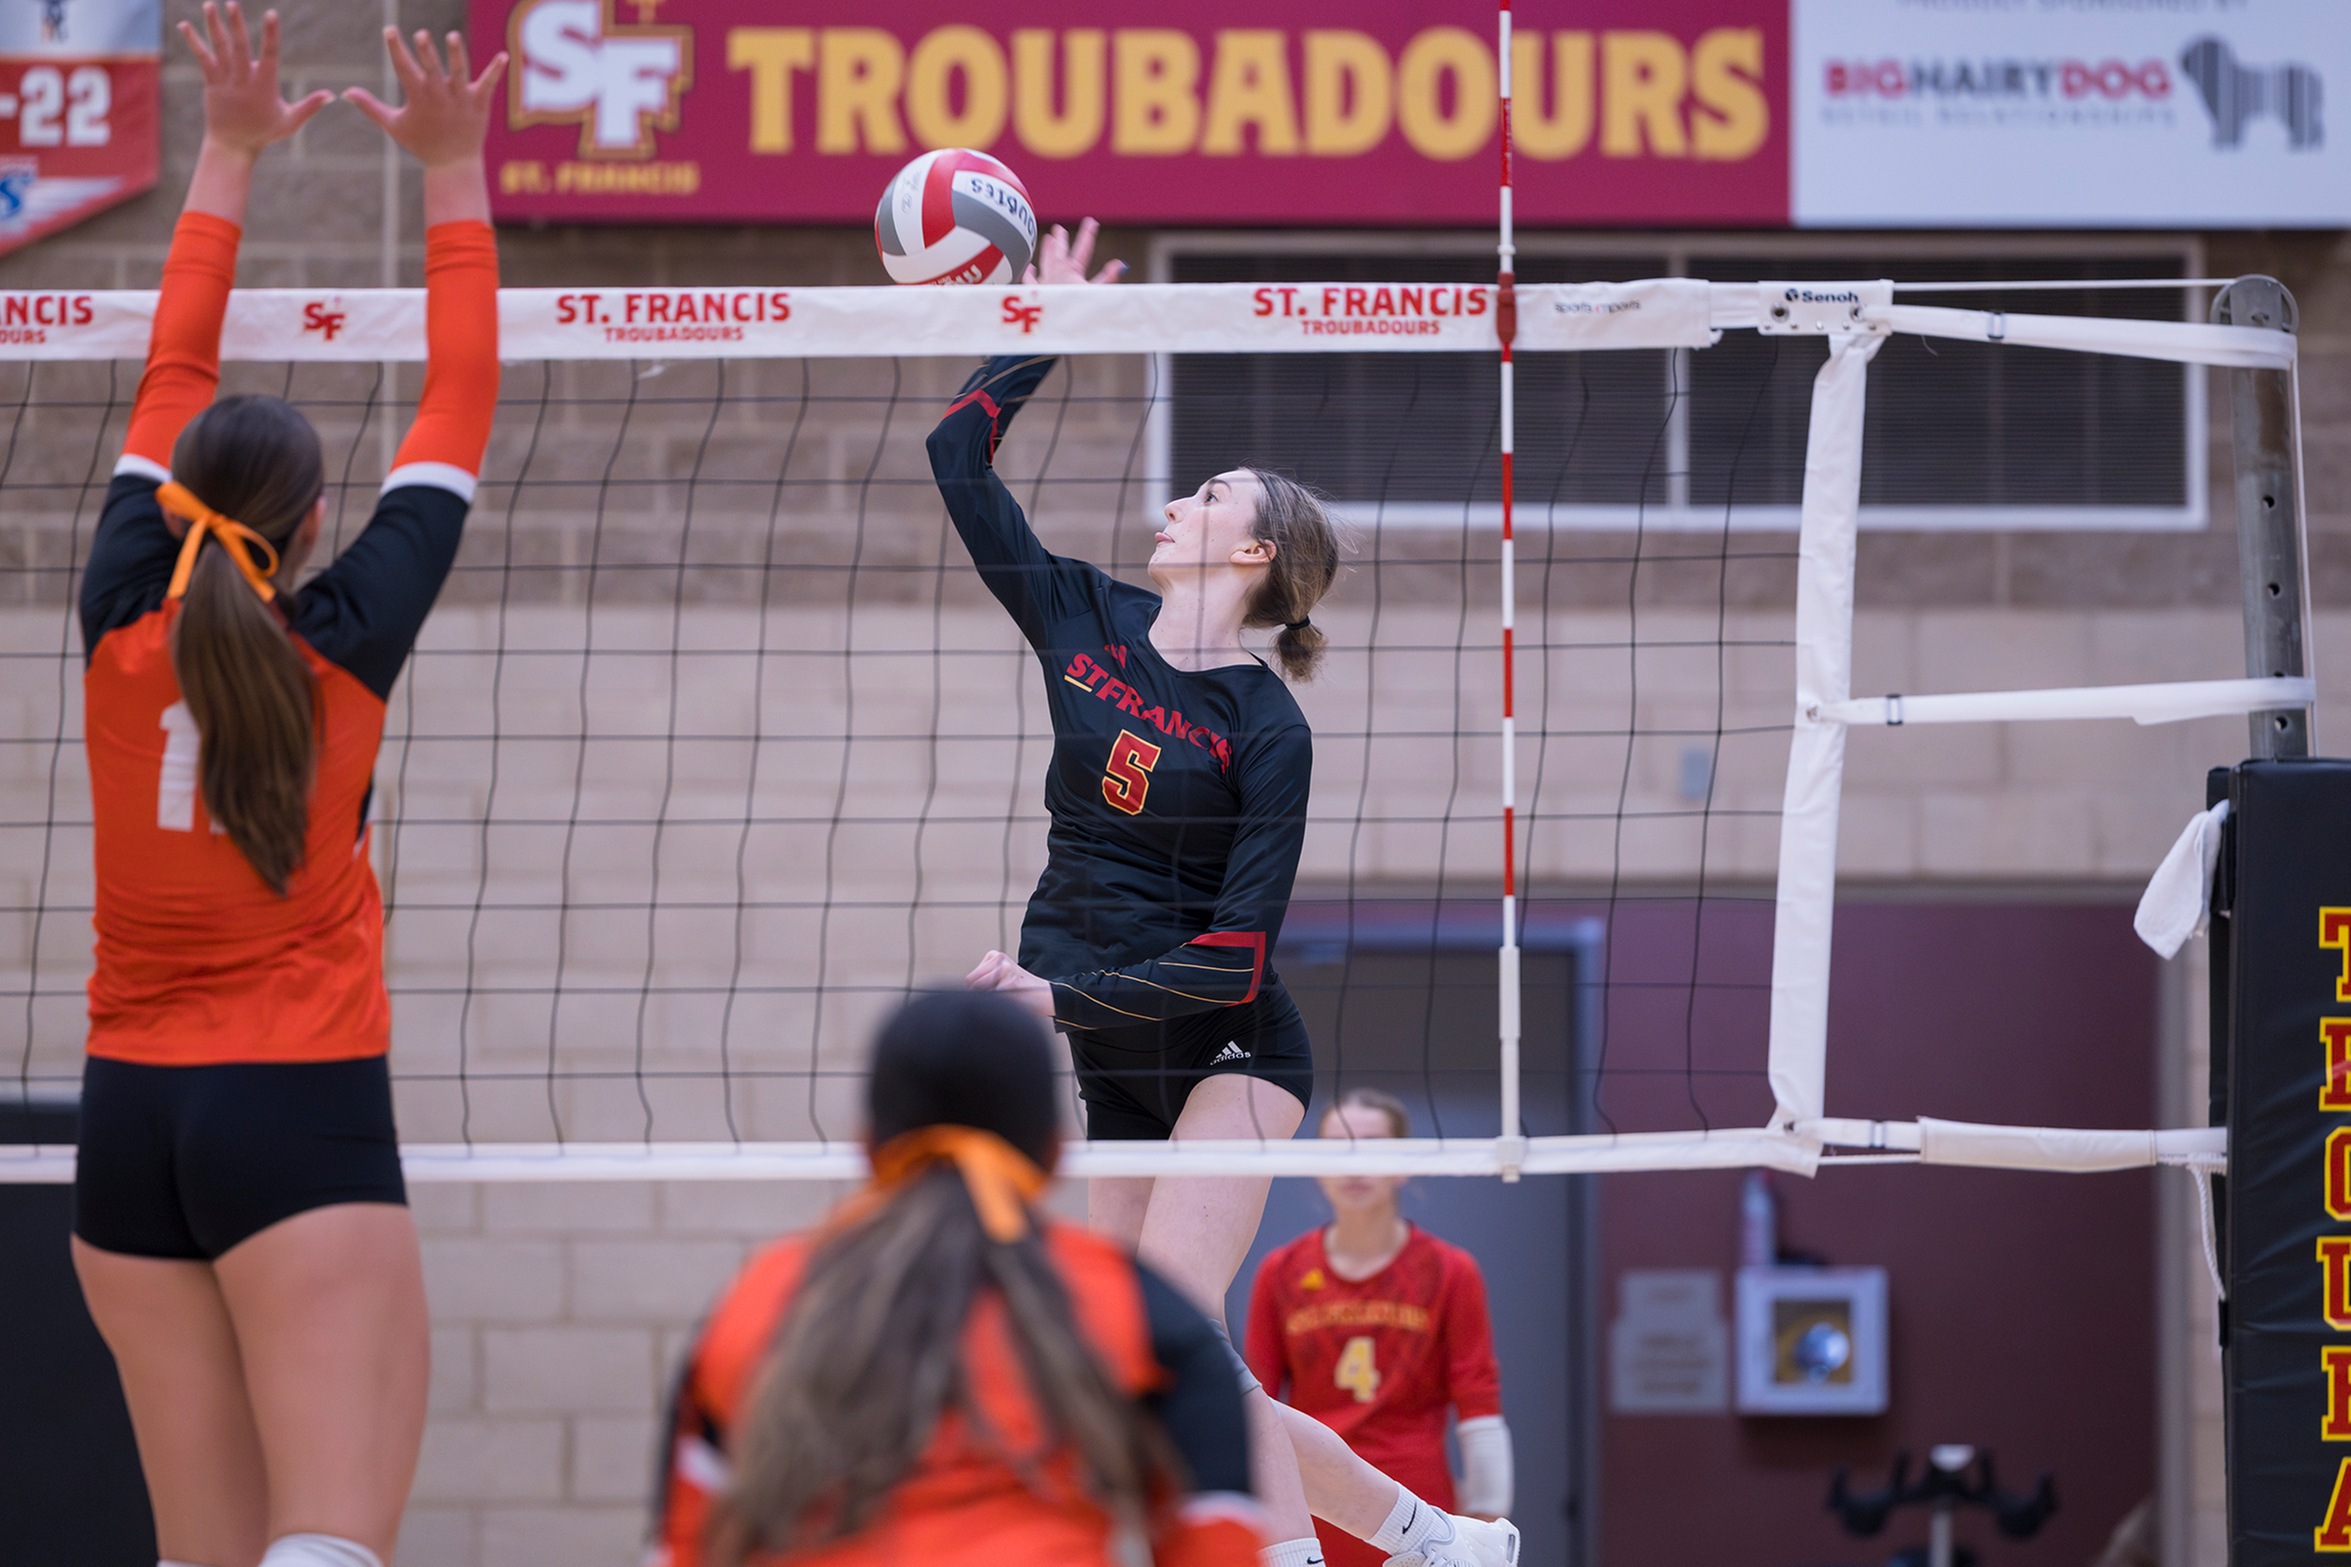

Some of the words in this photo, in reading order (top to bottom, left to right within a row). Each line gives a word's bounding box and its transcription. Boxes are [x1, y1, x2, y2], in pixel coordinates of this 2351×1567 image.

[726, 24, 1770, 161] TROUBADOURS
[0, 295, 94, 326] NCIS
[556, 294, 610, 324] ST.
[624, 292, 791, 323] FRANCIS
[1002, 295, 1042, 333] SF
[1253, 287, 1307, 317] ST.
[1321, 286, 1488, 317] FRANCIS
[1801, 290, 1859, 303] Senoh
[303, 301, 346, 341] SF
[604, 327, 744, 343] TROUBADOURS
[1301, 319, 1441, 335] TROUBADOURS
[157, 698, 229, 836] 1
[1101, 728, 1162, 816] 5
[1333, 1335, 1382, 1403] 4
